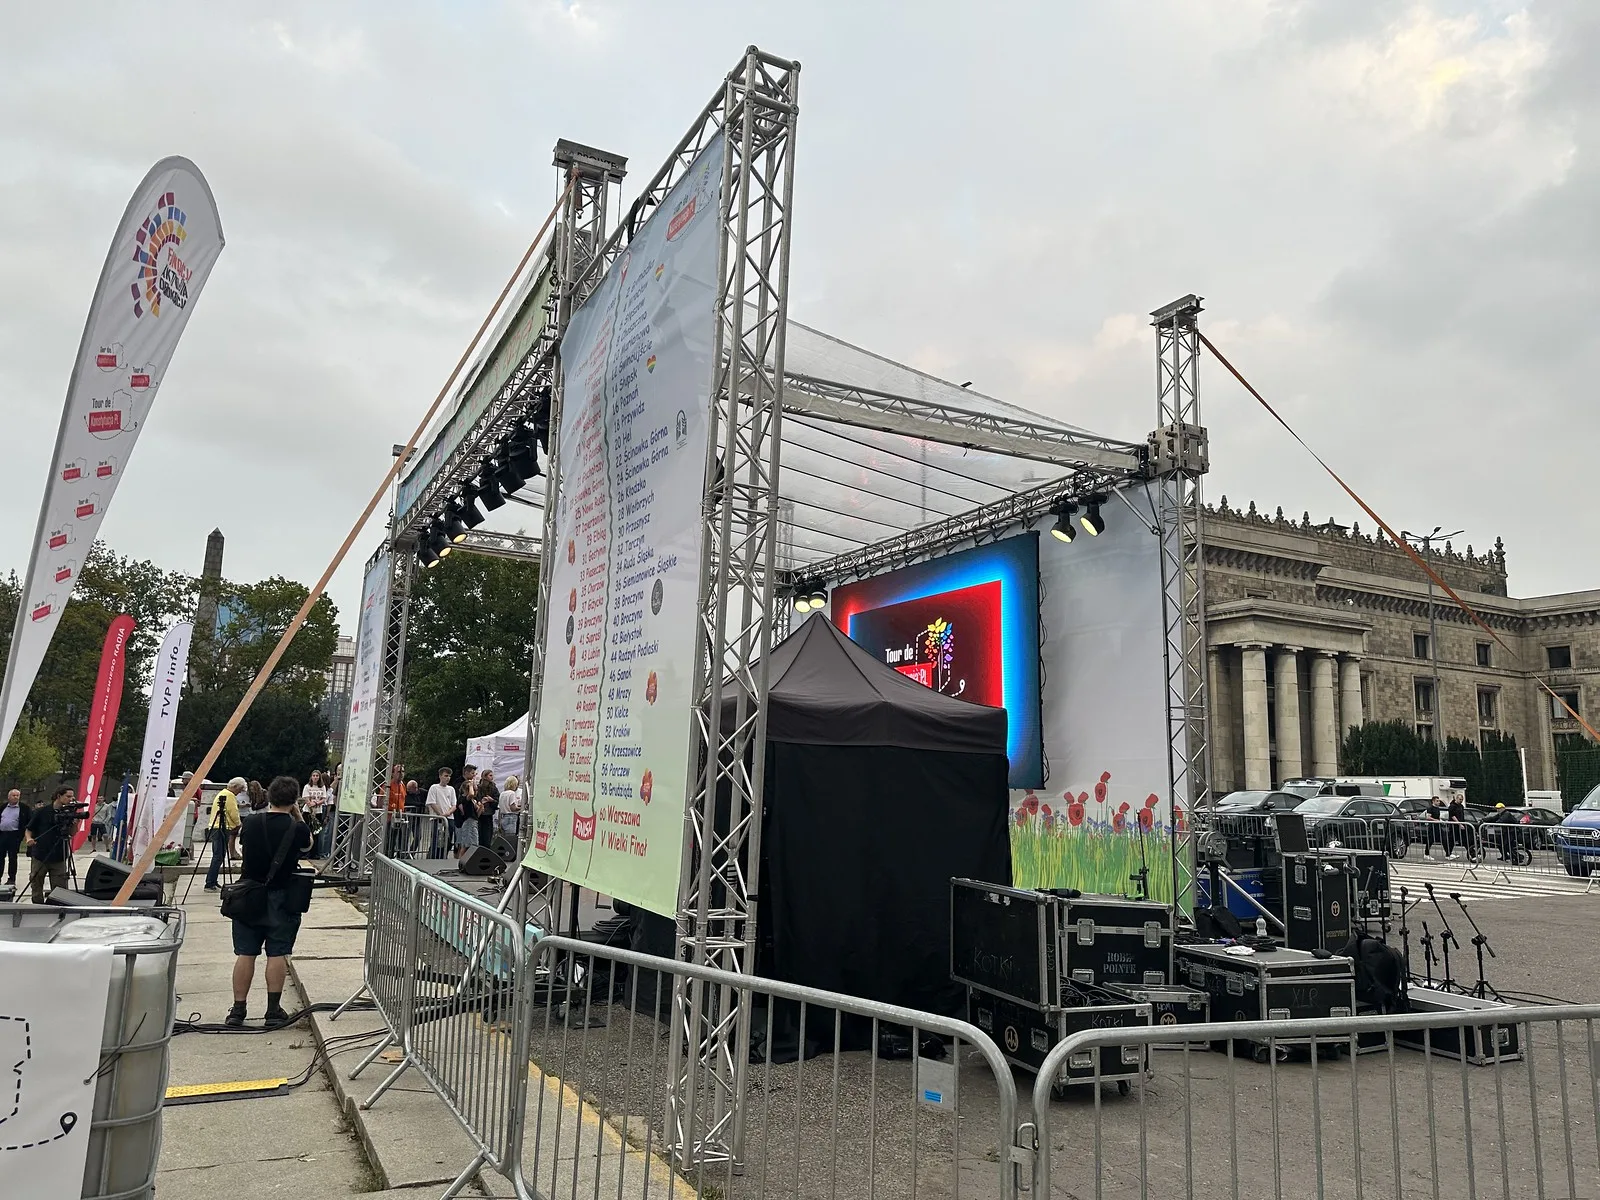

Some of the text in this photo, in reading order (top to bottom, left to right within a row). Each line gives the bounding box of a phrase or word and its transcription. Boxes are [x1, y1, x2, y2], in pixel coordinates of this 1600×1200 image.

[612, 383, 618, 398] 14
[620, 368, 637, 391] Słupsk
[92, 396, 111, 409] Tour de
[613, 402, 618, 415] 16
[620, 384, 638, 407] Poznań
[614, 419, 620, 433] 18
[622, 401, 644, 424] Przywidz
[615, 428, 631, 450] 20 Hel
[616, 427, 668, 468] 22 Ścinawka Górna
[617, 446, 668, 486] 24 Ścinawka Górna
[618, 479, 646, 503] 26 Kłodzko
[618, 491, 654, 521] 28 Wałbrzych
[576, 524, 581, 536] 27
[618, 513, 650, 538] 30 Przasnysz
[587, 529, 606, 546] 29 Elbląg
[617, 535, 644, 556] 32 Tarczyn
[616, 548, 653, 574] 34 Ruda Śląska
[580, 563, 605, 582] 33 Piaseczno
[615, 556, 677, 592] 36 Siemianowice Śląskie
[581, 581, 604, 597] 35 Chorzów
[581, 601, 587, 613] 37
[614, 597, 620, 610] 38
[578, 619, 583, 630] 39
[613, 615, 619, 626] 40
[579, 635, 584, 645] 41
[586, 632, 600, 644] Supraśl
[612, 629, 642, 645] 42 Białystok
[582, 650, 587, 661] 43
[611, 641, 658, 662] 44 Radzyń Podlaski
[885, 643, 914, 664] Tour de
[103, 658, 116, 712] POLSKIEGO
[113, 628, 125, 657] RADIA
[570, 668, 598, 680] 45 Hrubieszów
[610, 669, 631, 682] 46 Sanok
[577, 684, 597, 694] 47 Krosno
[608, 688, 631, 701] 48 Mrozy
[160, 686, 172, 718] TVP
[576, 701, 596, 711] 49 Radom
[607, 707, 628, 719] 50 Kielce
[565, 719, 594, 732] 51 Tarnobrzeg
[605, 724, 630, 738] 52 Kraków
[572, 735, 594, 747] 53 Tarnów
[570, 753, 591, 764] 55 Zamość
[604, 744, 641, 757] 54 Krzeszowice
[569, 770, 590, 783] 57 Sieradz
[602, 763, 629, 776] 56 Parczew
[550, 786, 589, 801] 59 Buk-Niepruszewo
[601, 782, 632, 799] 58 Grudziądz
[600, 806, 640, 826] 60 Warszawa
[575, 818, 594, 838] FINISH
[601, 830, 647, 856] V Wielki Finał
[1103, 963, 1136, 974] POINTE
[1292, 987, 1319, 1008] XLR
